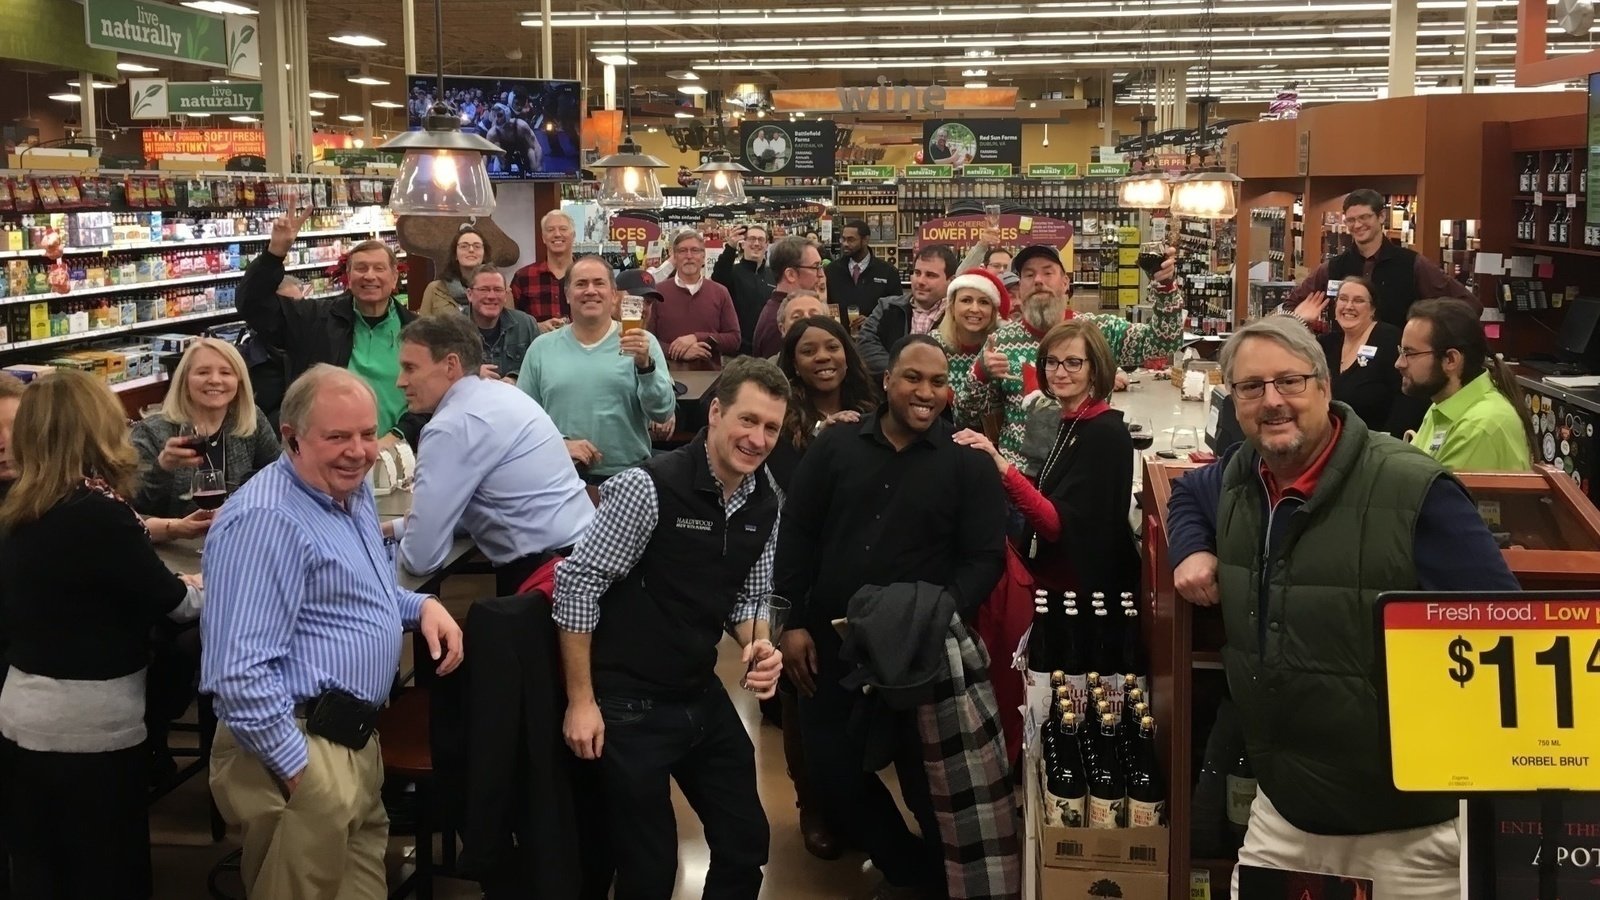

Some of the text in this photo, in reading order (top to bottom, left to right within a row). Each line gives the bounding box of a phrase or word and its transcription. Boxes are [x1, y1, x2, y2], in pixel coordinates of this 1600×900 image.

[136, 6, 159, 27] live
[101, 18, 181, 54] naturally
[212, 86, 232, 97] live
[836, 75, 946, 112] wine
[180, 93, 254, 110] naturally
[204, 131, 229, 142] SOFT
[233, 131, 260, 142] FRESH
[176, 143, 208, 153] STINKY
[957, 220, 986, 228] CHEERS
[922, 228, 967, 241] LOWER
[1426, 603, 1480, 621] Fresh
[1486, 603, 1537, 621] food.
[1544, 603, 1590, 621] Low
[1512, 756, 1589, 767] KORBEL BRUT
